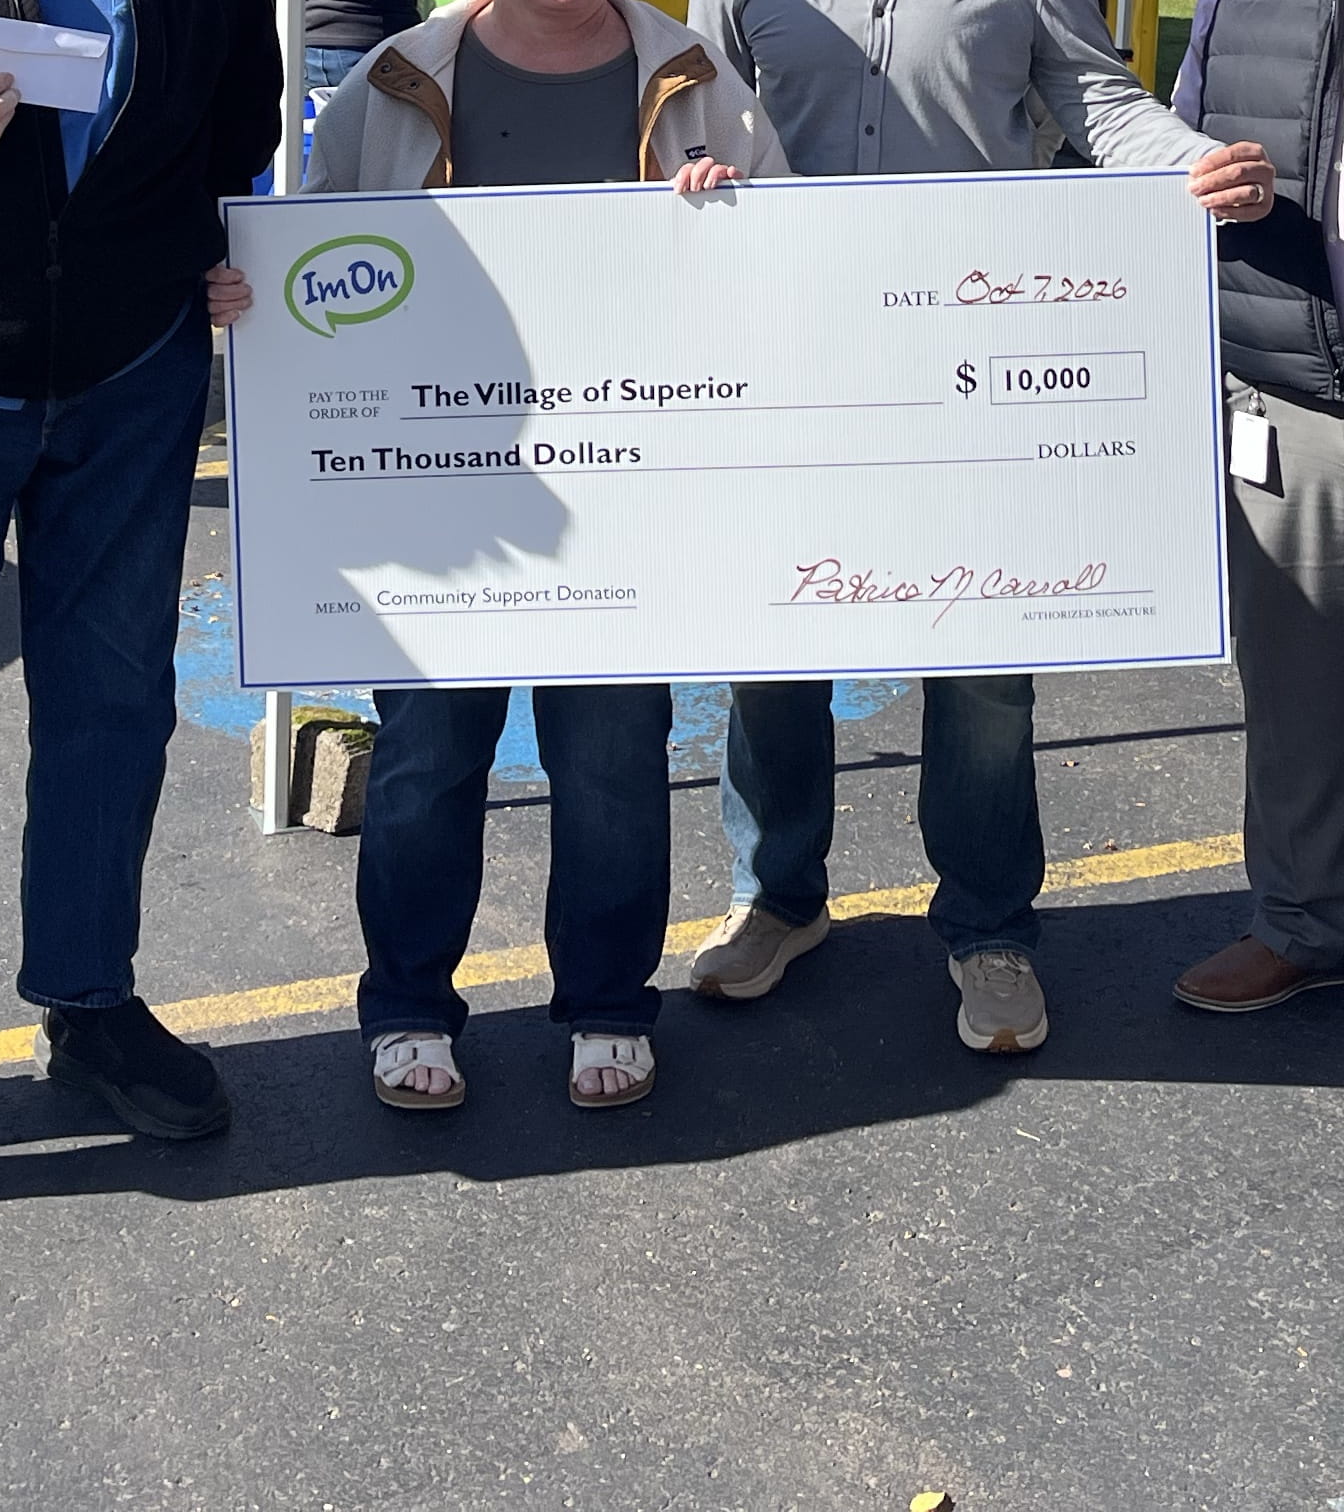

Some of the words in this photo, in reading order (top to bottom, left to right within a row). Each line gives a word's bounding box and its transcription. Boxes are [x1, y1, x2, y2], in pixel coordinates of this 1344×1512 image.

[301, 260, 398, 306] ImOn
[882, 291, 940, 307] DATE
[955, 359, 977, 400] $
[1005, 366, 1091, 396] 10,000
[308, 391, 334, 403] PAY
[334, 390, 357, 403] TO
[359, 389, 390, 402] THE
[411, 384, 470, 408] The
[474, 382, 572, 411] Village
[582, 378, 613, 403] of
[620, 376, 749, 408] Superior
[308, 407, 358, 420] ORDER
[361, 406, 381, 418] OF
[311, 449, 365, 473] Ten
[371, 443, 521, 472] Thousand
[533, 441, 642, 466] Dollars
[1037, 440, 1137, 460] DOLLARS
[376, 589, 477, 609] Community
[482, 587, 552, 607] Support
[556, 584, 637, 602] Donation
[315, 601, 361, 614] MEMO
[1021, 608, 1094, 622] AUTHORIZED
[1095, 605, 1157, 619] SIGNATURE
